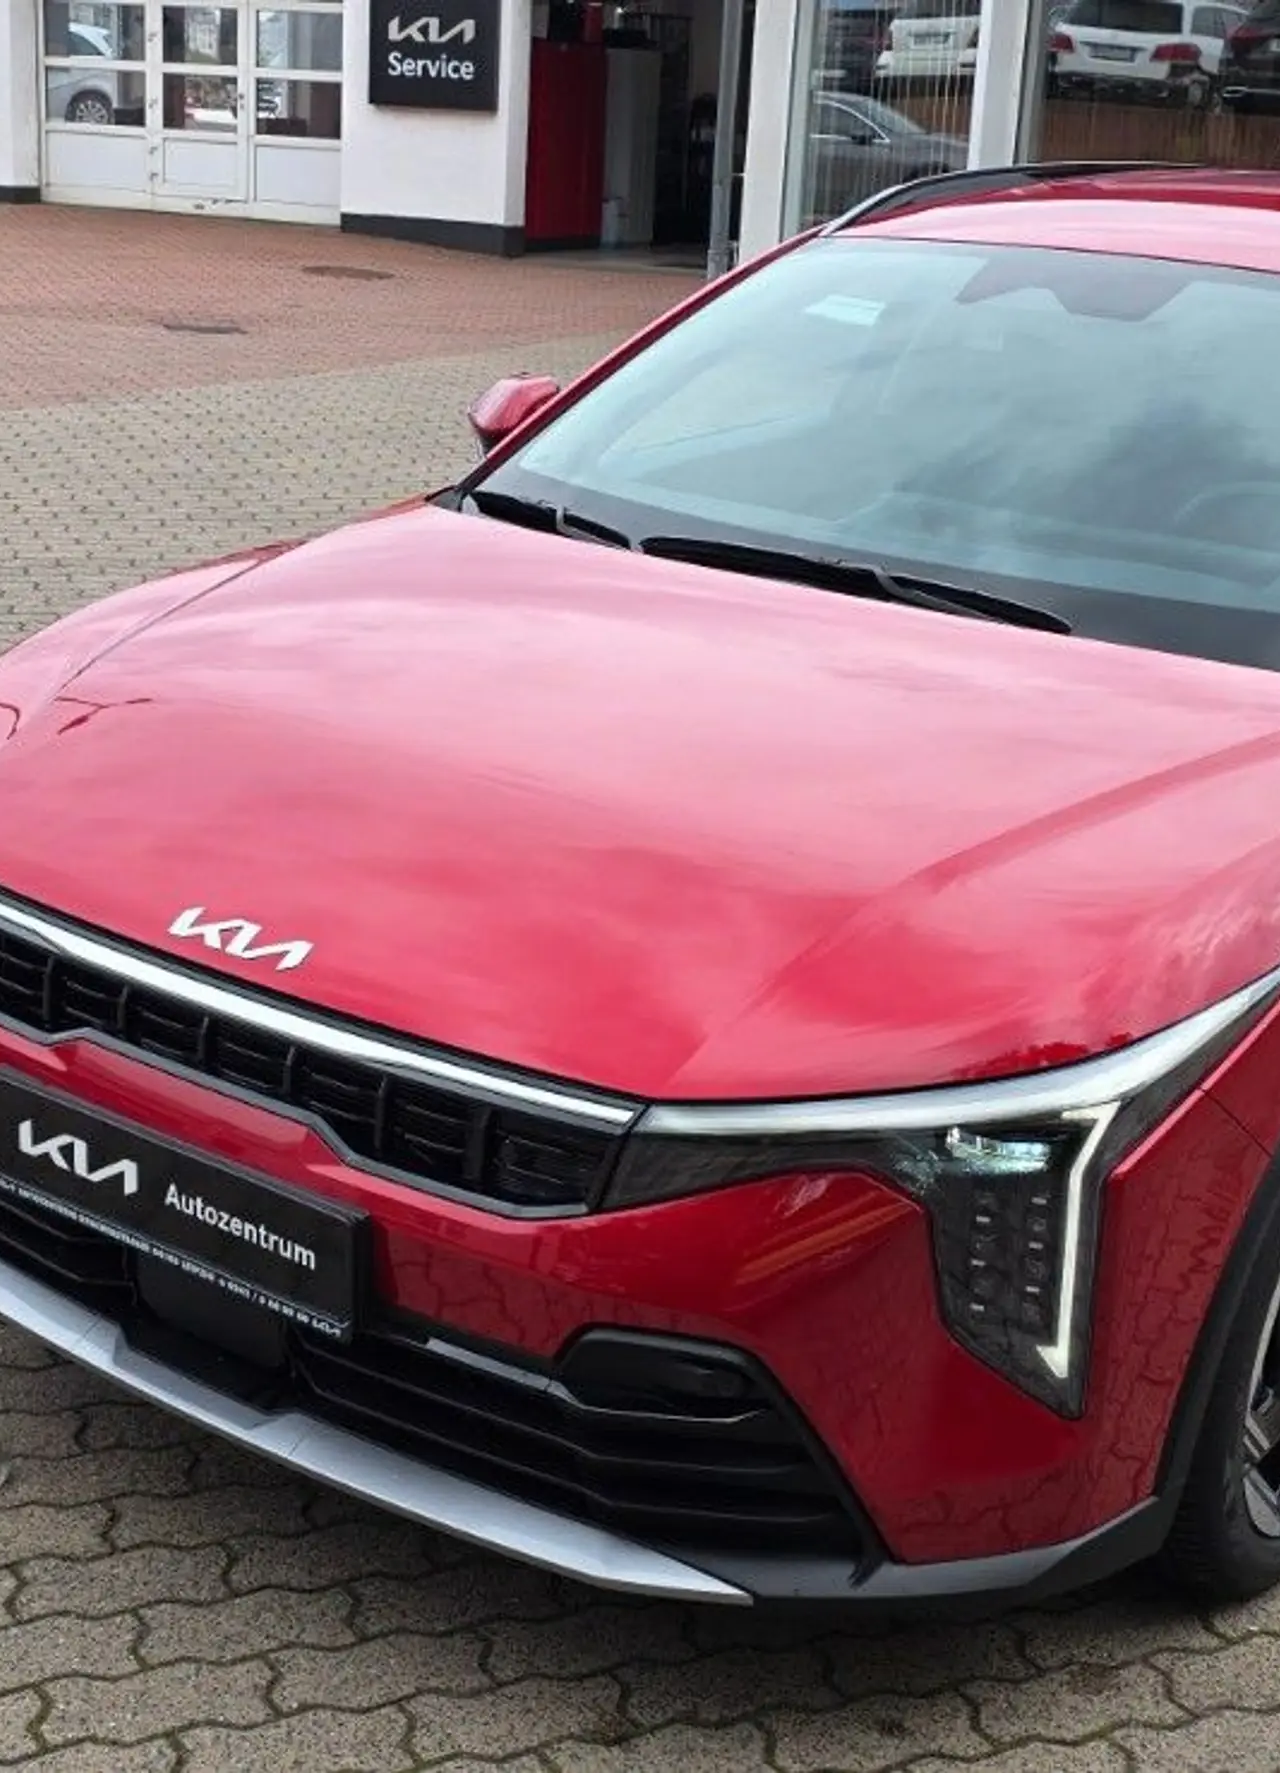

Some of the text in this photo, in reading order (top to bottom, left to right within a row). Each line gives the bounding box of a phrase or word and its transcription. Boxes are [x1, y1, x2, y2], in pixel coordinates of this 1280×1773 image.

[387, 16, 476, 44] KIA
[387, 51, 475, 80] Service
[167, 906, 314, 971] KIA
[19, 1119, 138, 1196] KIA
[164, 1181, 316, 1271] Autozentrum
